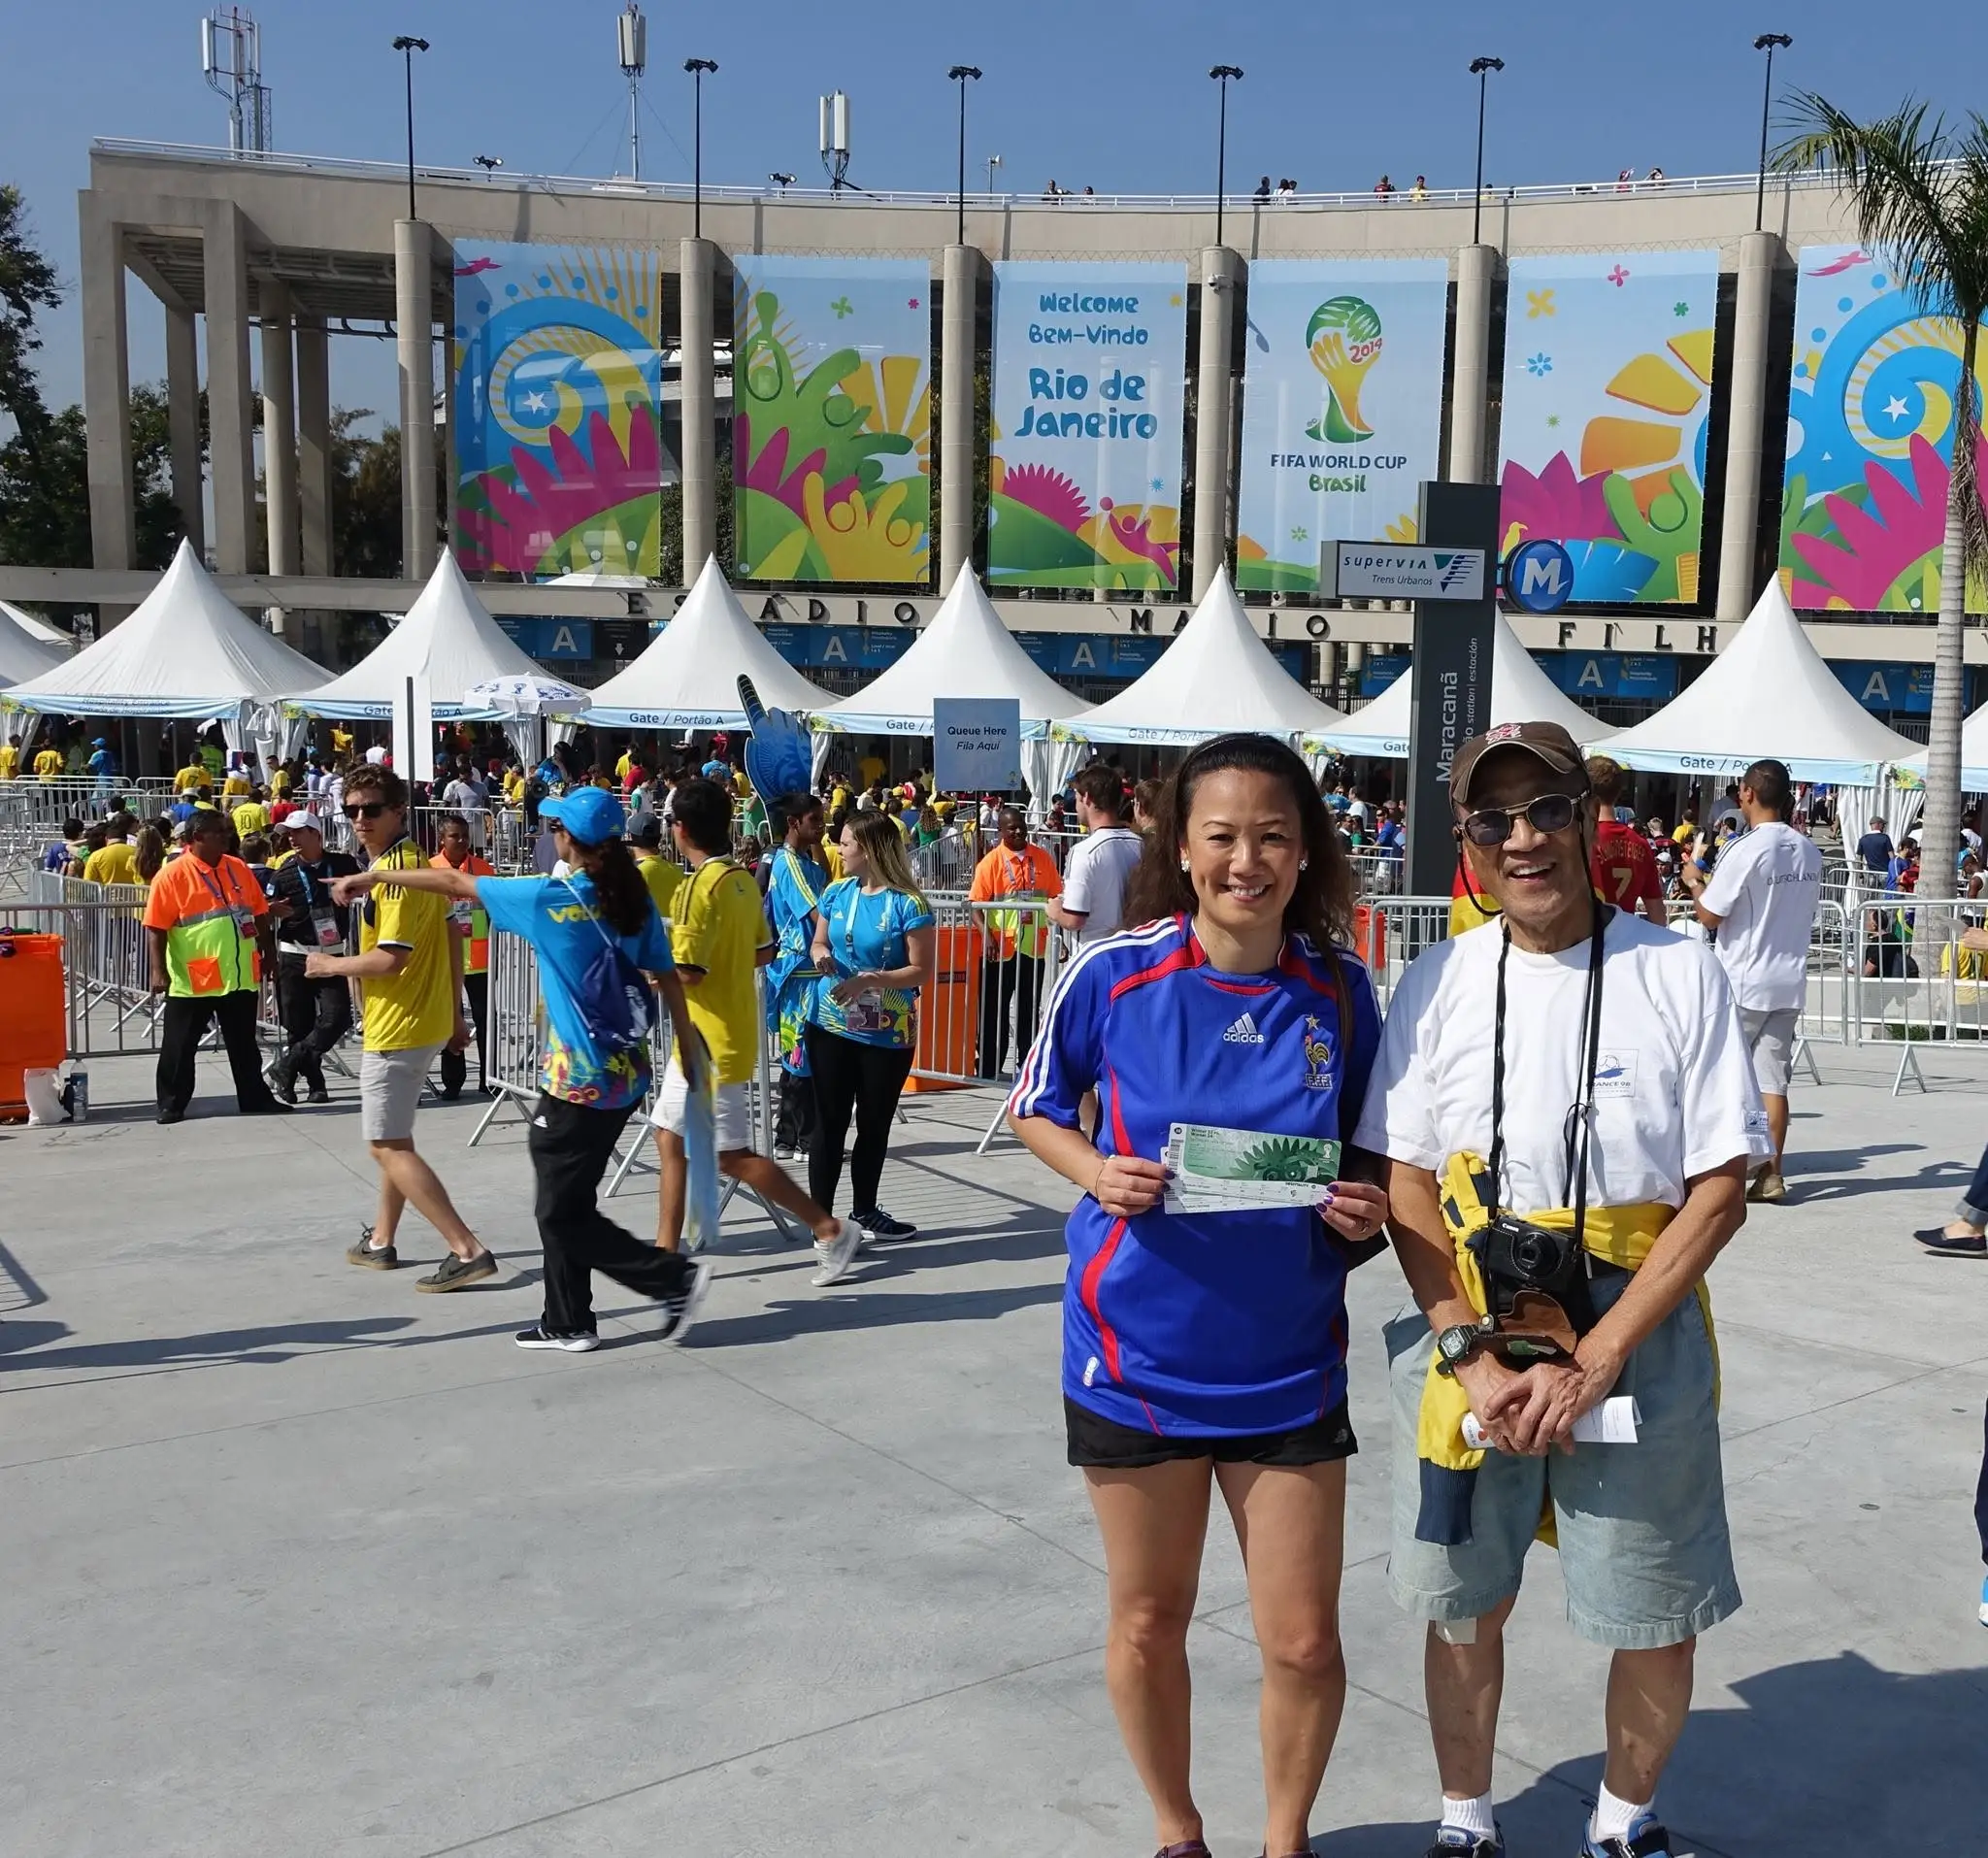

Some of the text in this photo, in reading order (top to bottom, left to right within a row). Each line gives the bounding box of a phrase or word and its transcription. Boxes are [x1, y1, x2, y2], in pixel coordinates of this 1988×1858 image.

[1348, 337, 1383, 364] 2014
[1028, 367, 1146, 401] Rio de
[1013, 406, 1159, 440] Janeiro
[1270, 453, 1408, 470] FIFA WORLD CUP
[1308, 473, 1367, 493] Brasil
[1372, 574, 1433, 586] Trens Urbanos
[1520, 558, 1566, 595] M
[551, 625, 578, 653] A
[822, 635, 848, 662] A
[1071, 642, 1096, 668] A
[1468, 637, 1478, 682] estación
[1576, 659, 1604, 688] A
[1861, 671, 1890, 701] A
[364, 705, 393, 715] Gate
[1467, 687, 1477, 724] station
[629, 713, 659, 724] Gate
[674, 714, 712, 725] Portão
[886, 718, 915, 730] Gate
[947, 726, 1008, 736] Queue Here
[1436, 672, 1458, 782] Maracanã
[956, 741, 974, 750] Fila
[1128, 728, 1158, 740] Gate
[1680, 756, 1715, 770] Gate
[1611, 867, 1633, 903] 7
[1767, 872, 1818, 886] DUTSCHLAND
[1222, 1031, 1266, 1044] adidas
